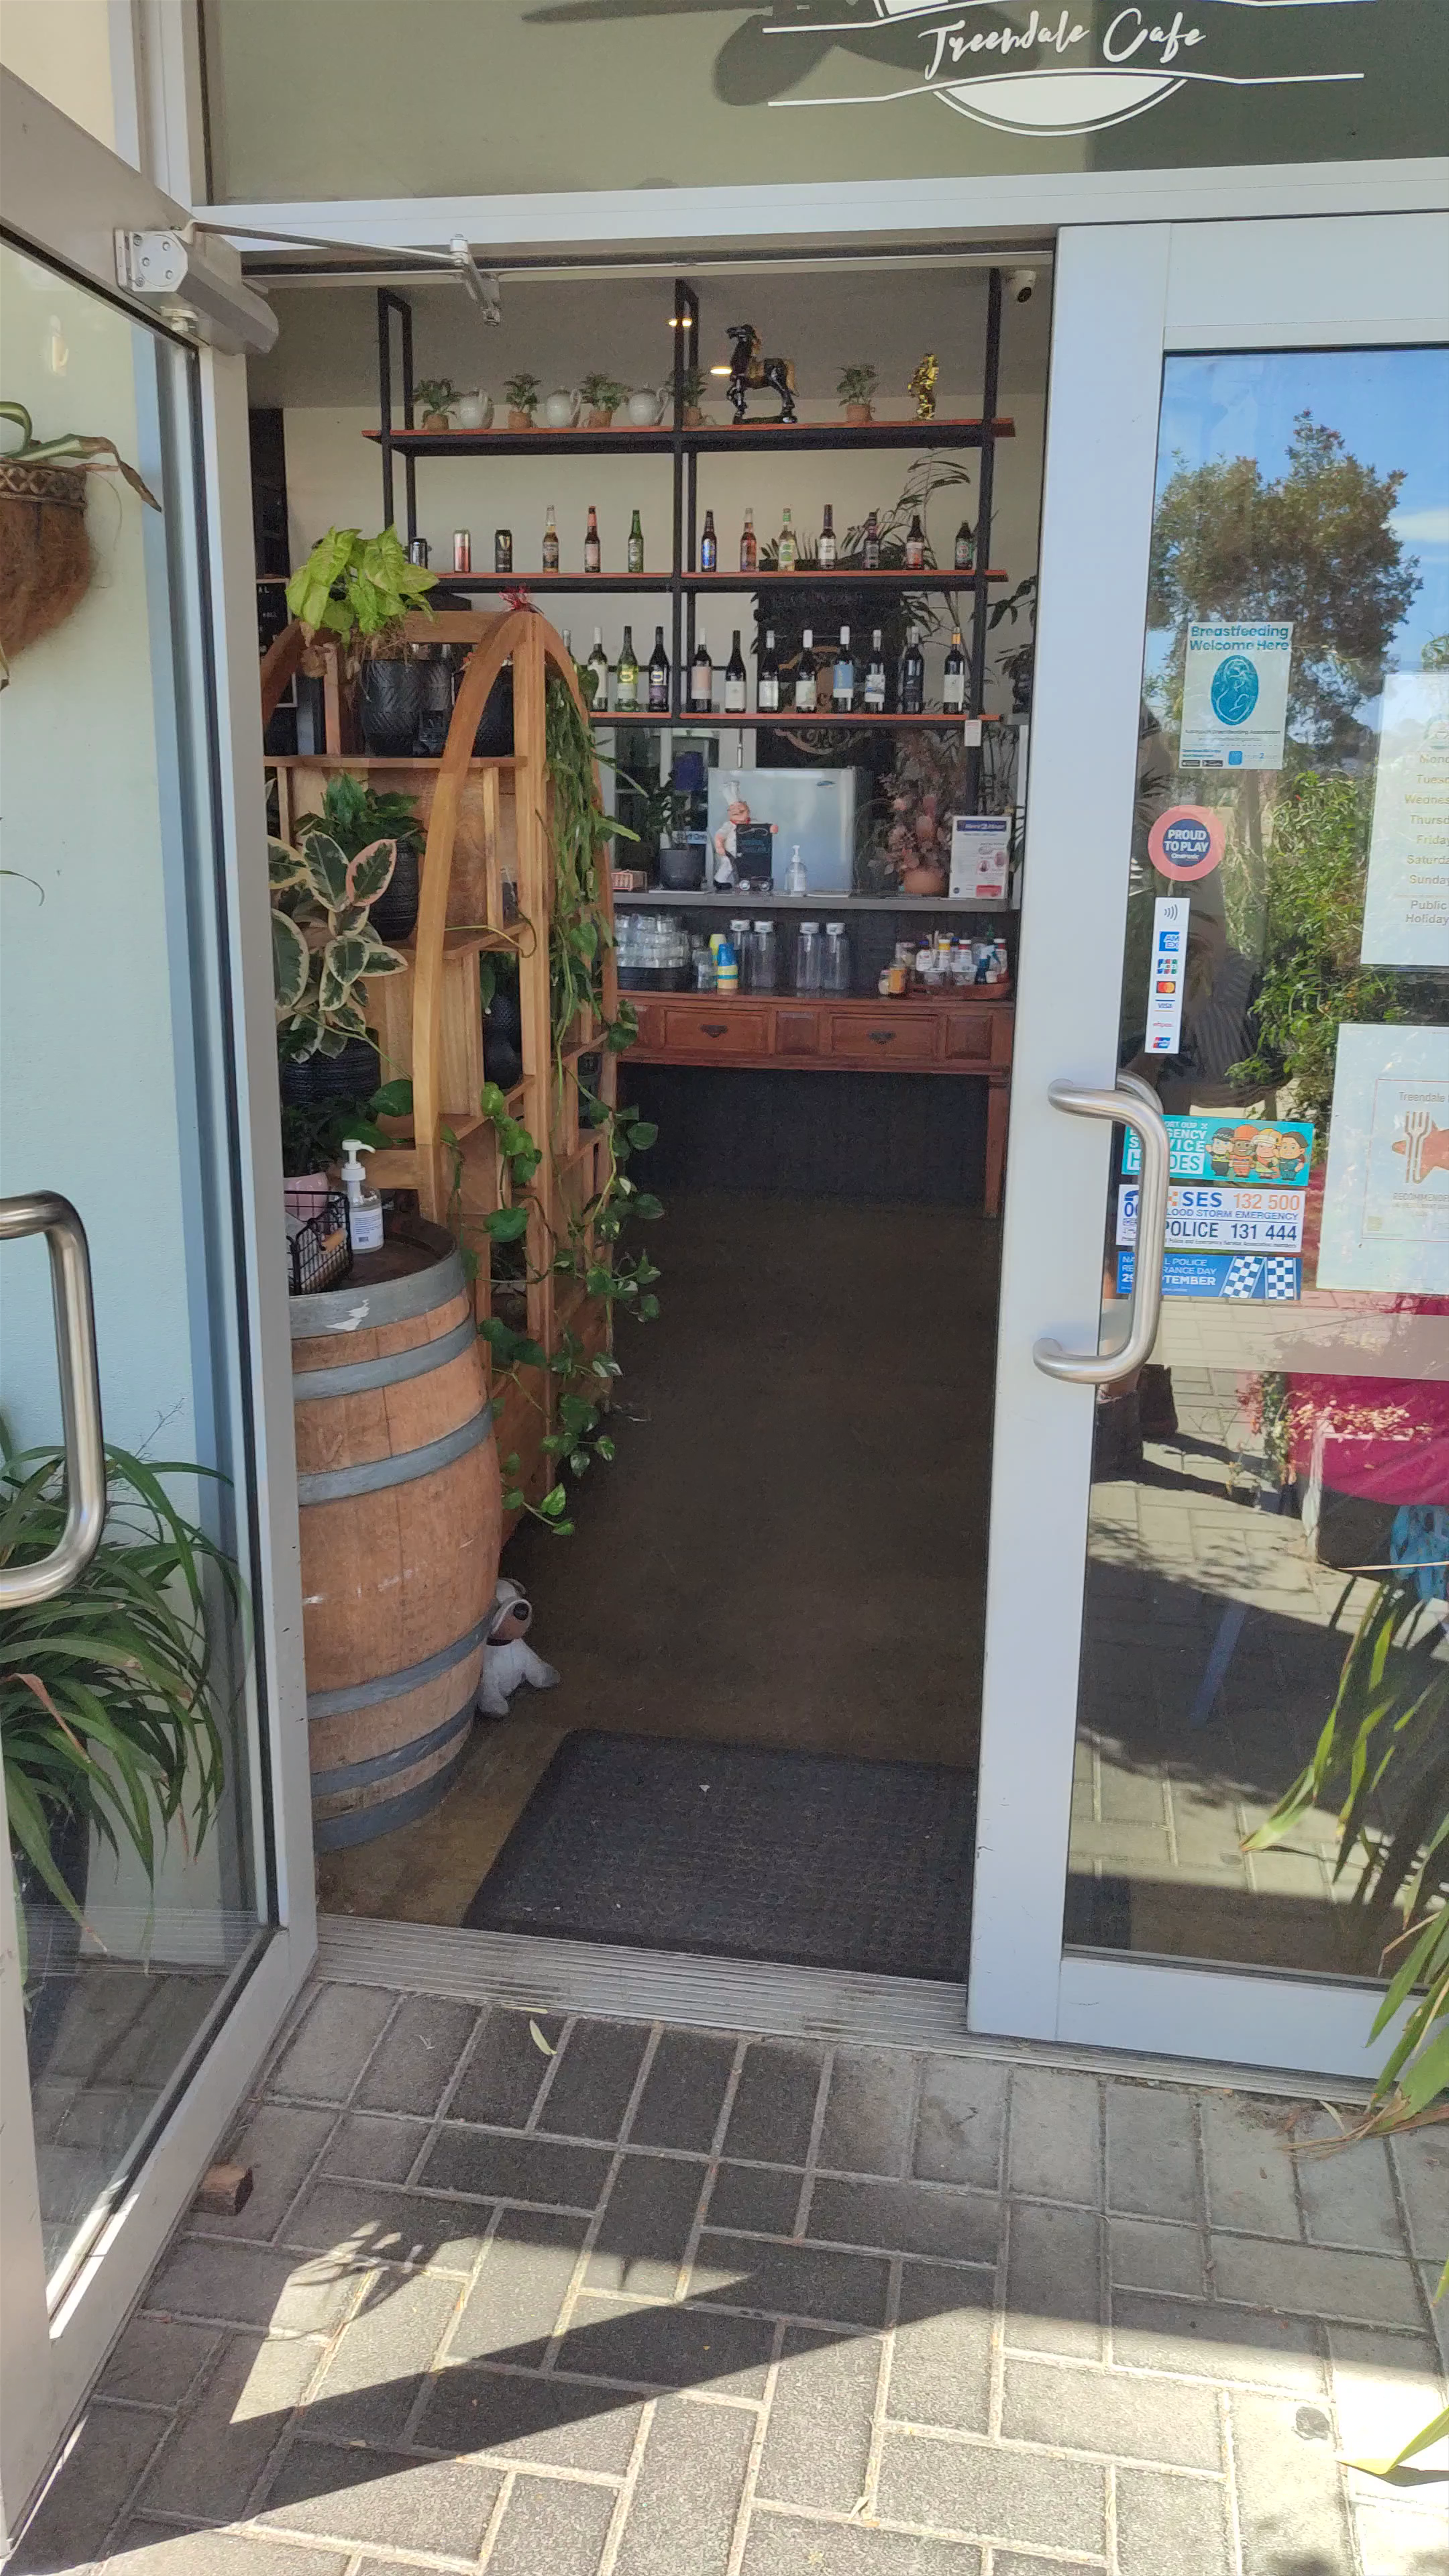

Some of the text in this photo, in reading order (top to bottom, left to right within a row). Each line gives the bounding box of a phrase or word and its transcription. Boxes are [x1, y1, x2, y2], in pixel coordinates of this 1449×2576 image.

[918, 8, 1206, 80] Treendale Cafe
[1191, 624, 1289, 640] Breastfeeding
[1190, 640, 1289, 651] Welcome Here
[1168, 829, 1207, 840] PROUD
[1164, 841, 1209, 852] TO PLAY
[1411, 900, 1447, 910] Public
[1398, 1092, 1445, 1103] Treendale
[1182, 1191, 1300, 1210] SES 132 500
[1196, 1209, 1232, 1218] STORM
[1235, 1210, 1299, 1221] EMERGENCY
[1231, 1223, 1257, 1240] 131
[1265, 1225, 1297, 1241] 444
[1172, 1258, 1208, 1266] POLICE
